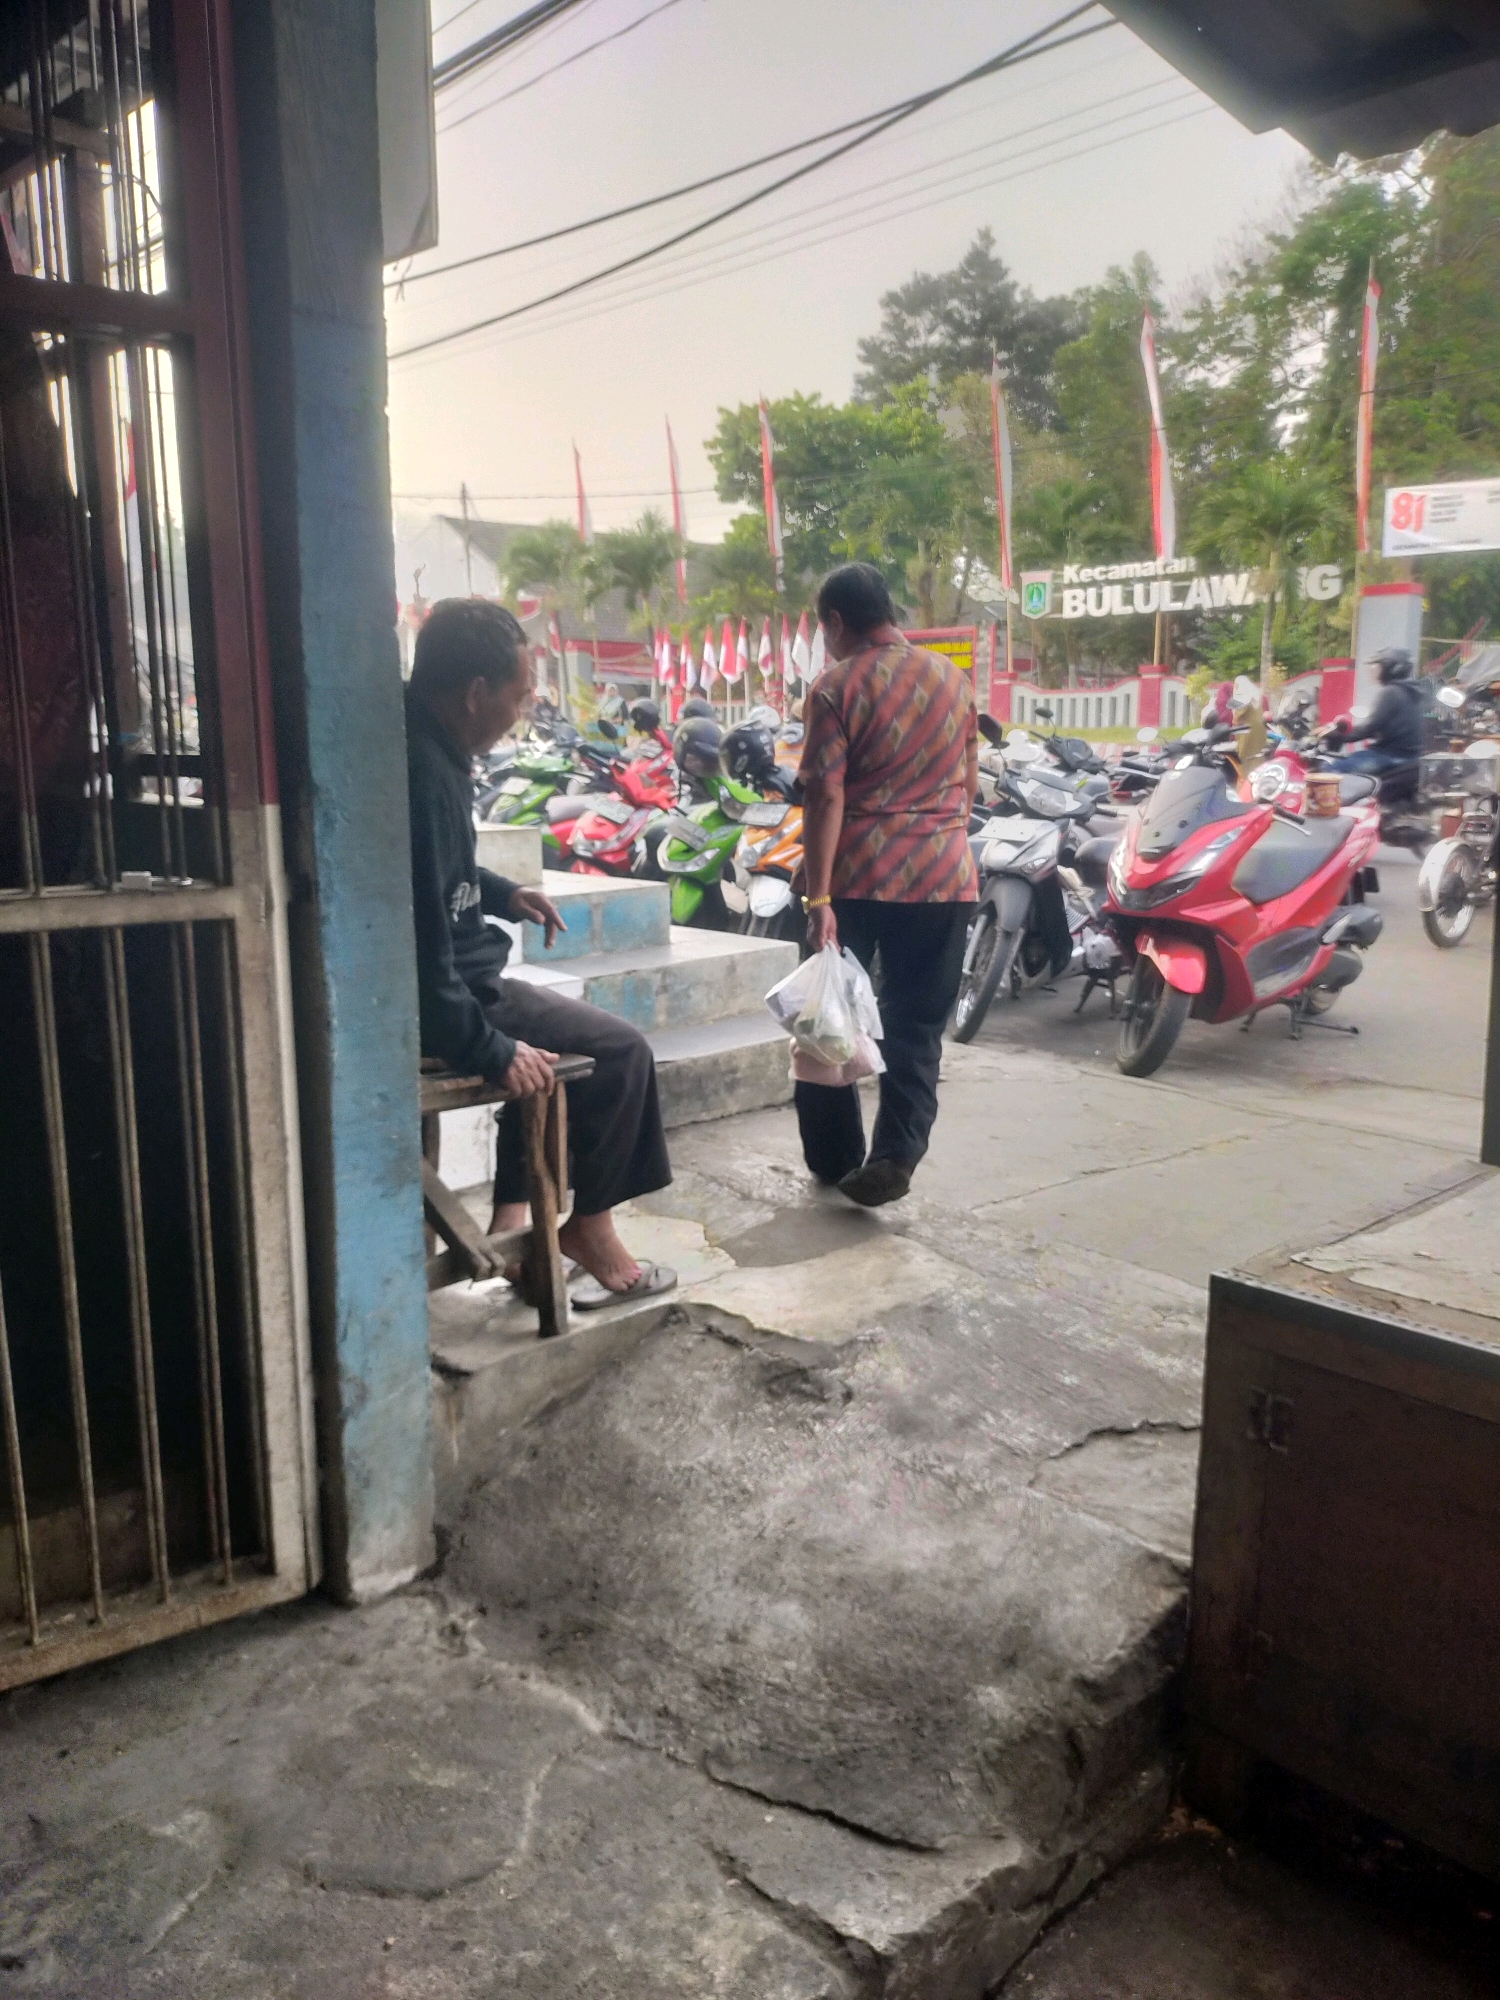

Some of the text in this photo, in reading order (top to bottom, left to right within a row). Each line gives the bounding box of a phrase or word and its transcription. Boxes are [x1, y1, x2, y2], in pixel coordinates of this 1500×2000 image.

[1391, 492, 1427, 533] 81
[1063, 556, 1197, 584] Kecamatan
[1062, 564, 1343, 619] BULULAWG
